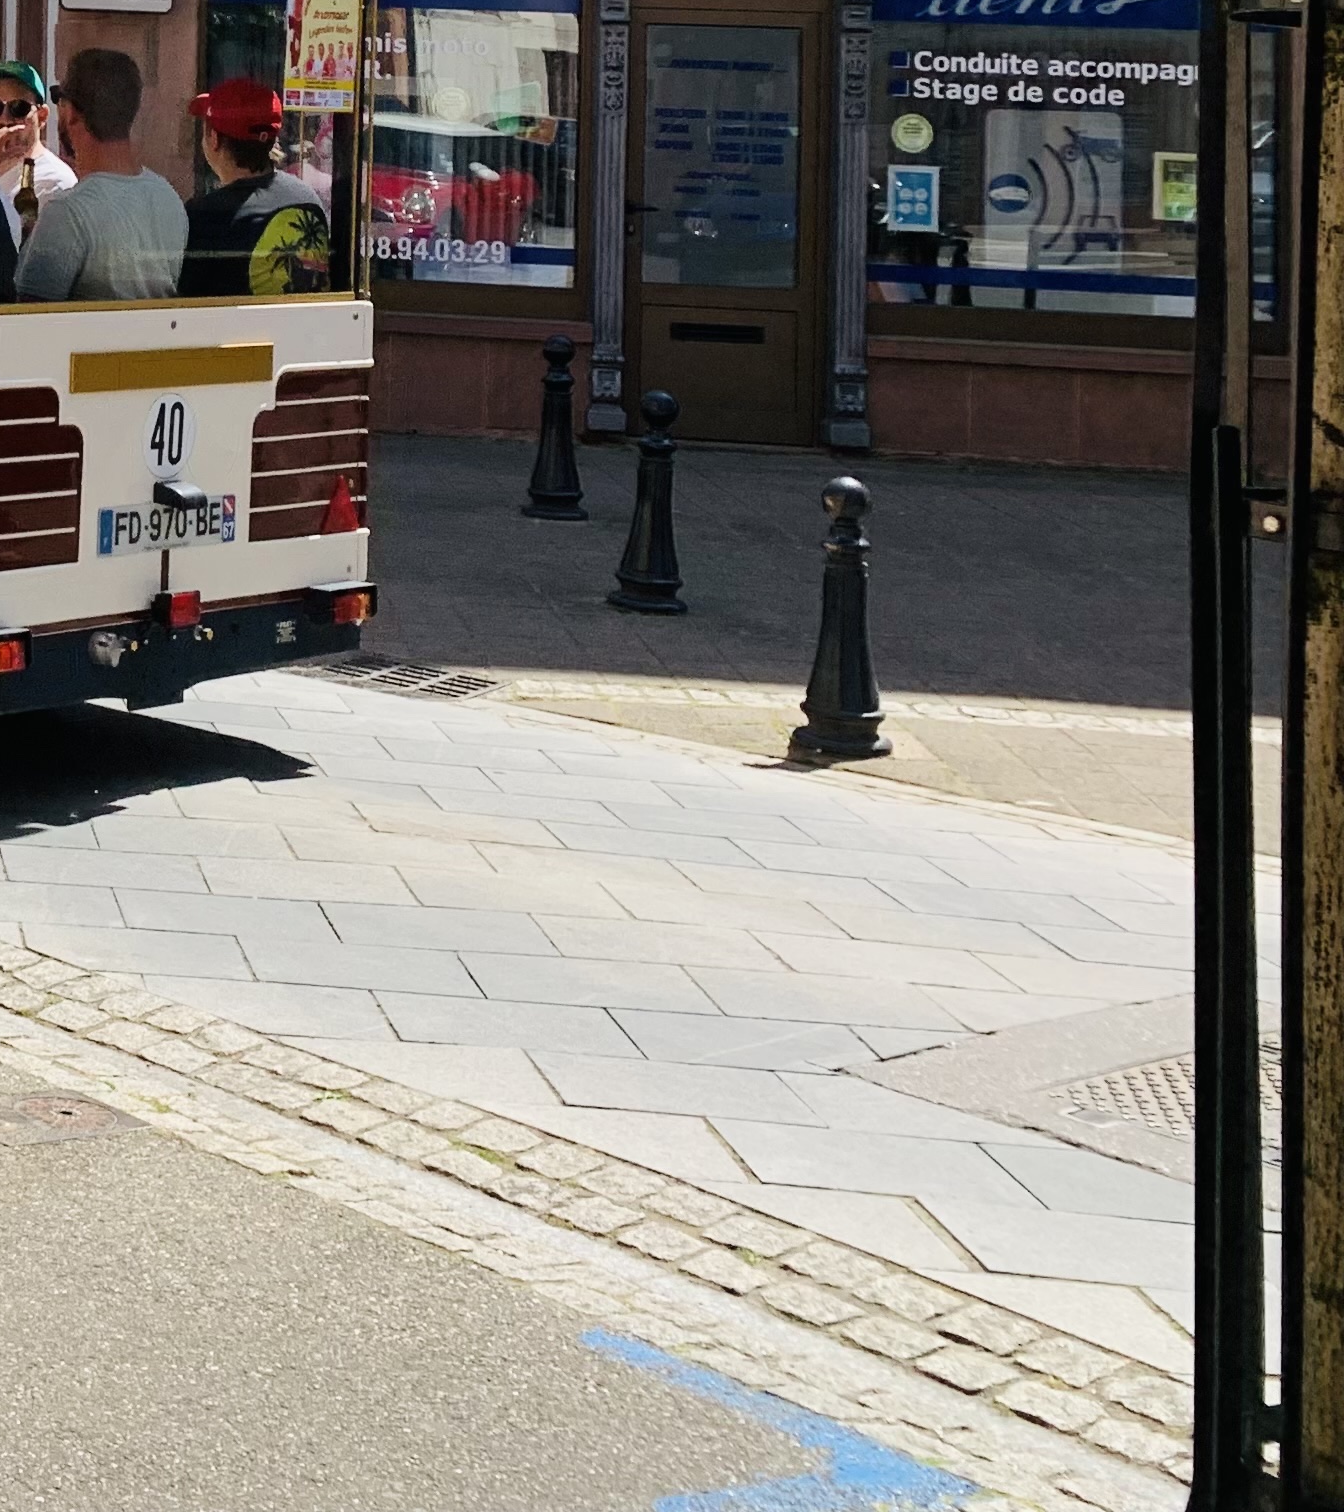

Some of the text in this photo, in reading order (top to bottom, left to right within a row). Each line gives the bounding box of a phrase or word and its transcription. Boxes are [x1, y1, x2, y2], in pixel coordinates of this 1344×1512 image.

[913, 50, 1039, 76] Conduite
[912, 77, 1126, 106] Stage de code
[150, 401, 185, 466] 40
[223, 522, 235, 539] 67
